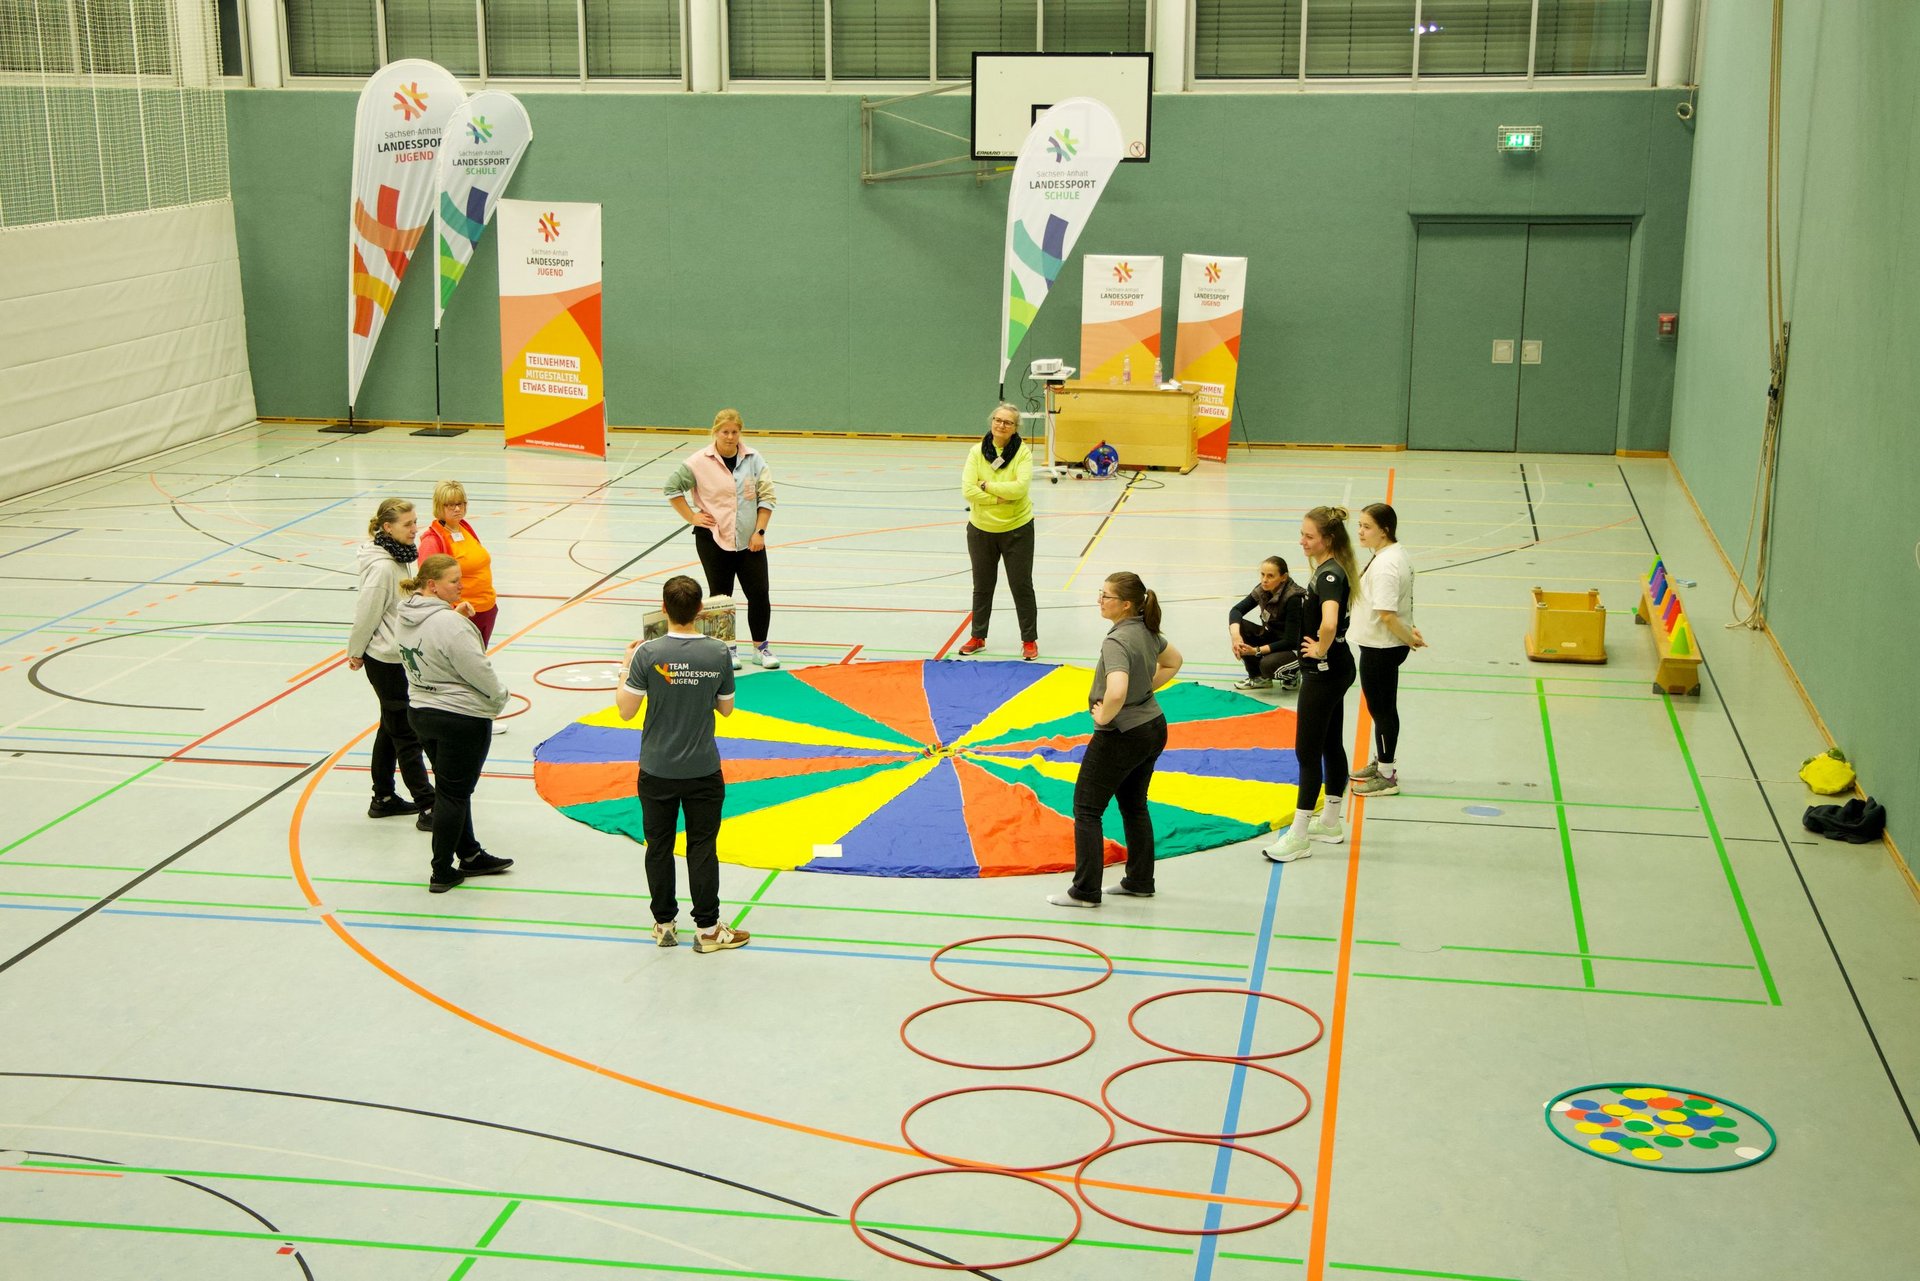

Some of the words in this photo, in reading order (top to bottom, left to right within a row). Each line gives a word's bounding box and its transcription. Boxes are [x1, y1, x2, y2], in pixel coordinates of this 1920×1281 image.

[385, 128, 441, 139] Sachsen-Anhalt
[394, 151, 434, 163] JUGEND
[452, 158, 510, 166] LANDESSPORT
[1030, 180, 1096, 189] LANDESSPORT
[1045, 191, 1080, 200] SCHULE
[526, 257, 574, 267] LANDESSPORT
[538, 268, 564, 276] JUGEND
[1194, 292, 1230, 300] LANDESSPORT
[528, 356, 578, 369] TEILNEHMEN.
[526, 369, 582, 384] MITGESTALTEN.
[522, 382, 546, 392] ETWAS
[548, 384, 586, 397] BEWEGEN.
[670, 670, 720, 678] LANDESSPORT
